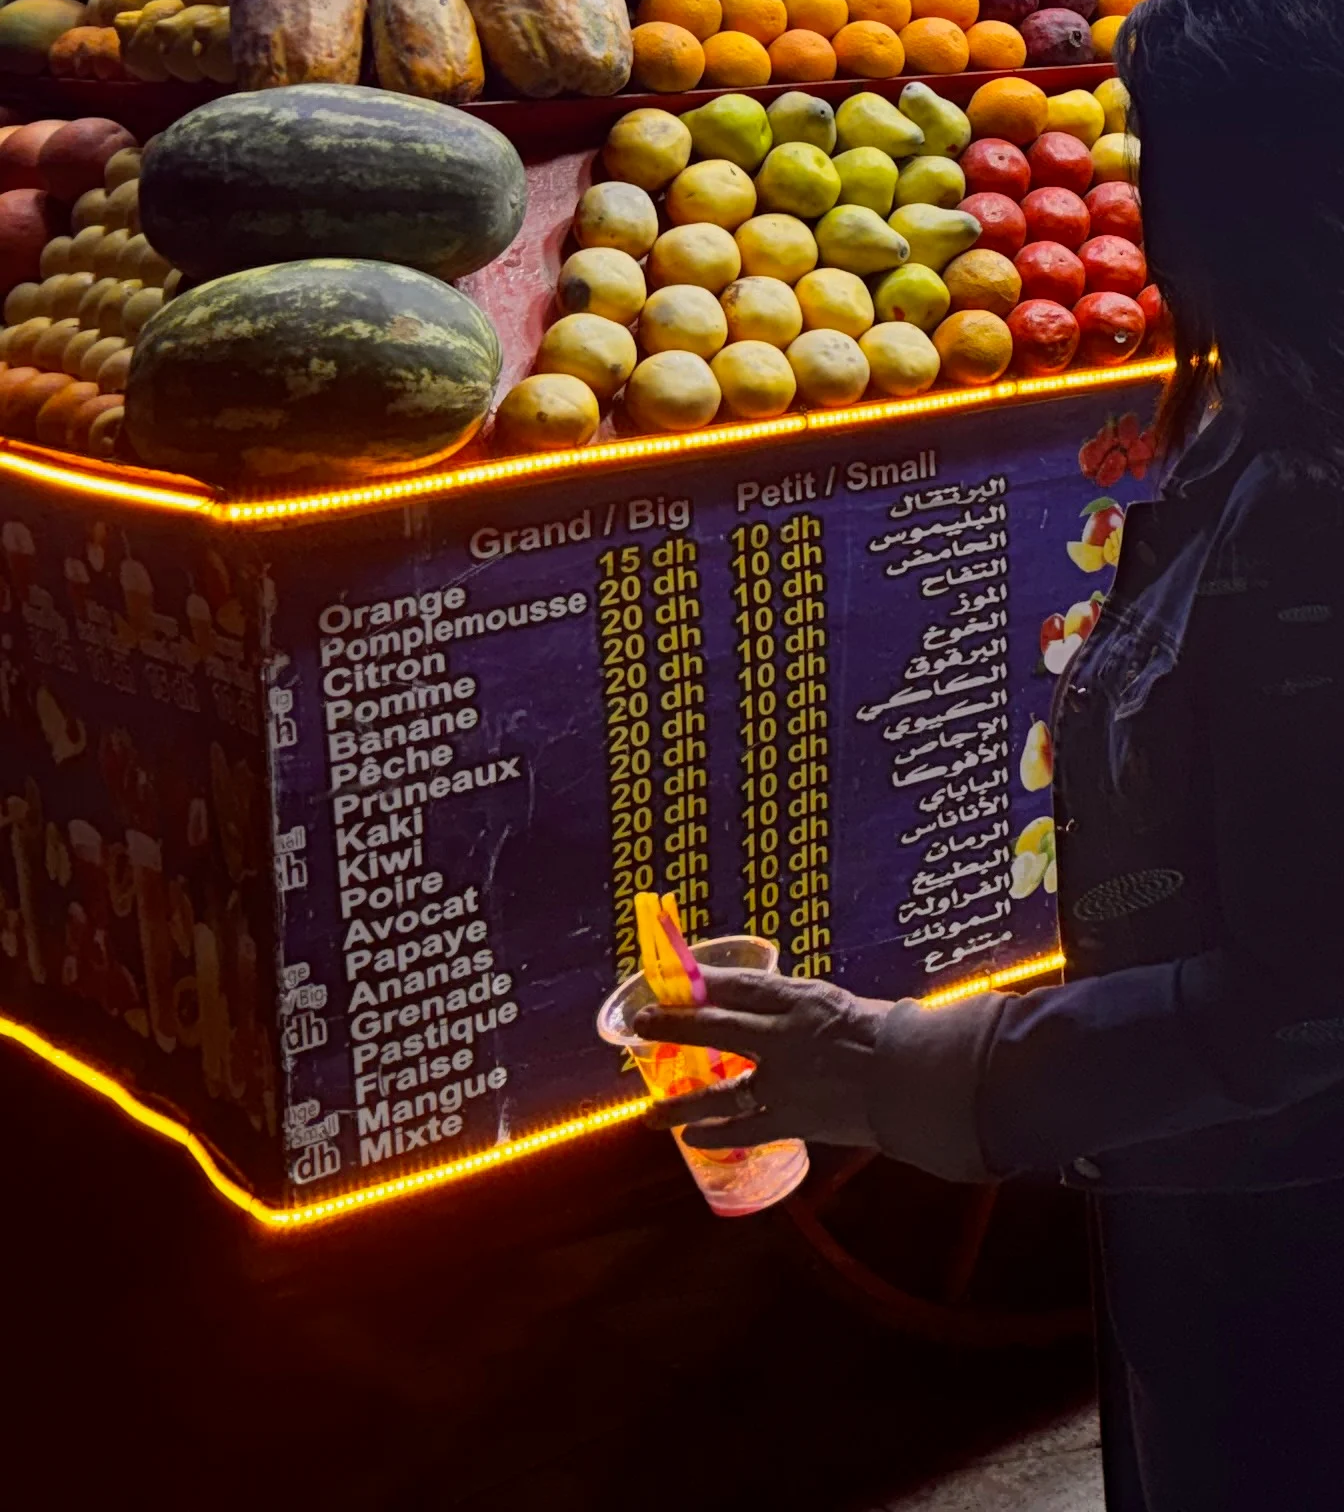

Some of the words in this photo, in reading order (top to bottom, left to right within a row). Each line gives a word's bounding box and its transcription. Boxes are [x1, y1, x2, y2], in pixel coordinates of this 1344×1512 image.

[737, 470, 817, 512] Petit
[846, 450, 937, 491] Small
[890, 478, 1005, 518] البرتقال
[469, 508, 592, 561] Grand
[628, 497, 691, 532] Big
[732, 523, 770, 552] 10
[781, 514, 821, 545] dh
[599, 546, 641, 577] 15
[652, 539, 696, 568] dh
[921, 557, 1007, 597] التفاح
[319, 587, 466, 634] Orange
[950, 583, 1007, 616] الموز
[321, 592, 587, 667] Pomplemousse
[922, 609, 1007, 650] الخوخ
[323, 651, 445, 697] Citron
[904, 636, 1007, 679] البرقوق
[326, 676, 476, 730] Pomme
[329, 707, 478, 762] Banane
[331, 744, 453, 790] Pêche
[334, 756, 521, 825] Pruneaux
[336, 807, 423, 856] Kaki
[925, 819, 1009, 862] الرمان
[338, 839, 423, 887] Kiwi
[912, 845, 1009, 895] البطيخ
[340, 871, 443, 919] Poire
[343, 886, 479, 951] Avocat
[346, 919, 488, 981] Papaye
[348, 948, 494, 1013] Ananas
[350, 971, 513, 1041] Grenade
[353, 1001, 518, 1075] Pastique
[355, 1048, 474, 1106] Fraise
[358, 1066, 508, 1137] Mangue
[360, 1114, 463, 1168] Mixte
